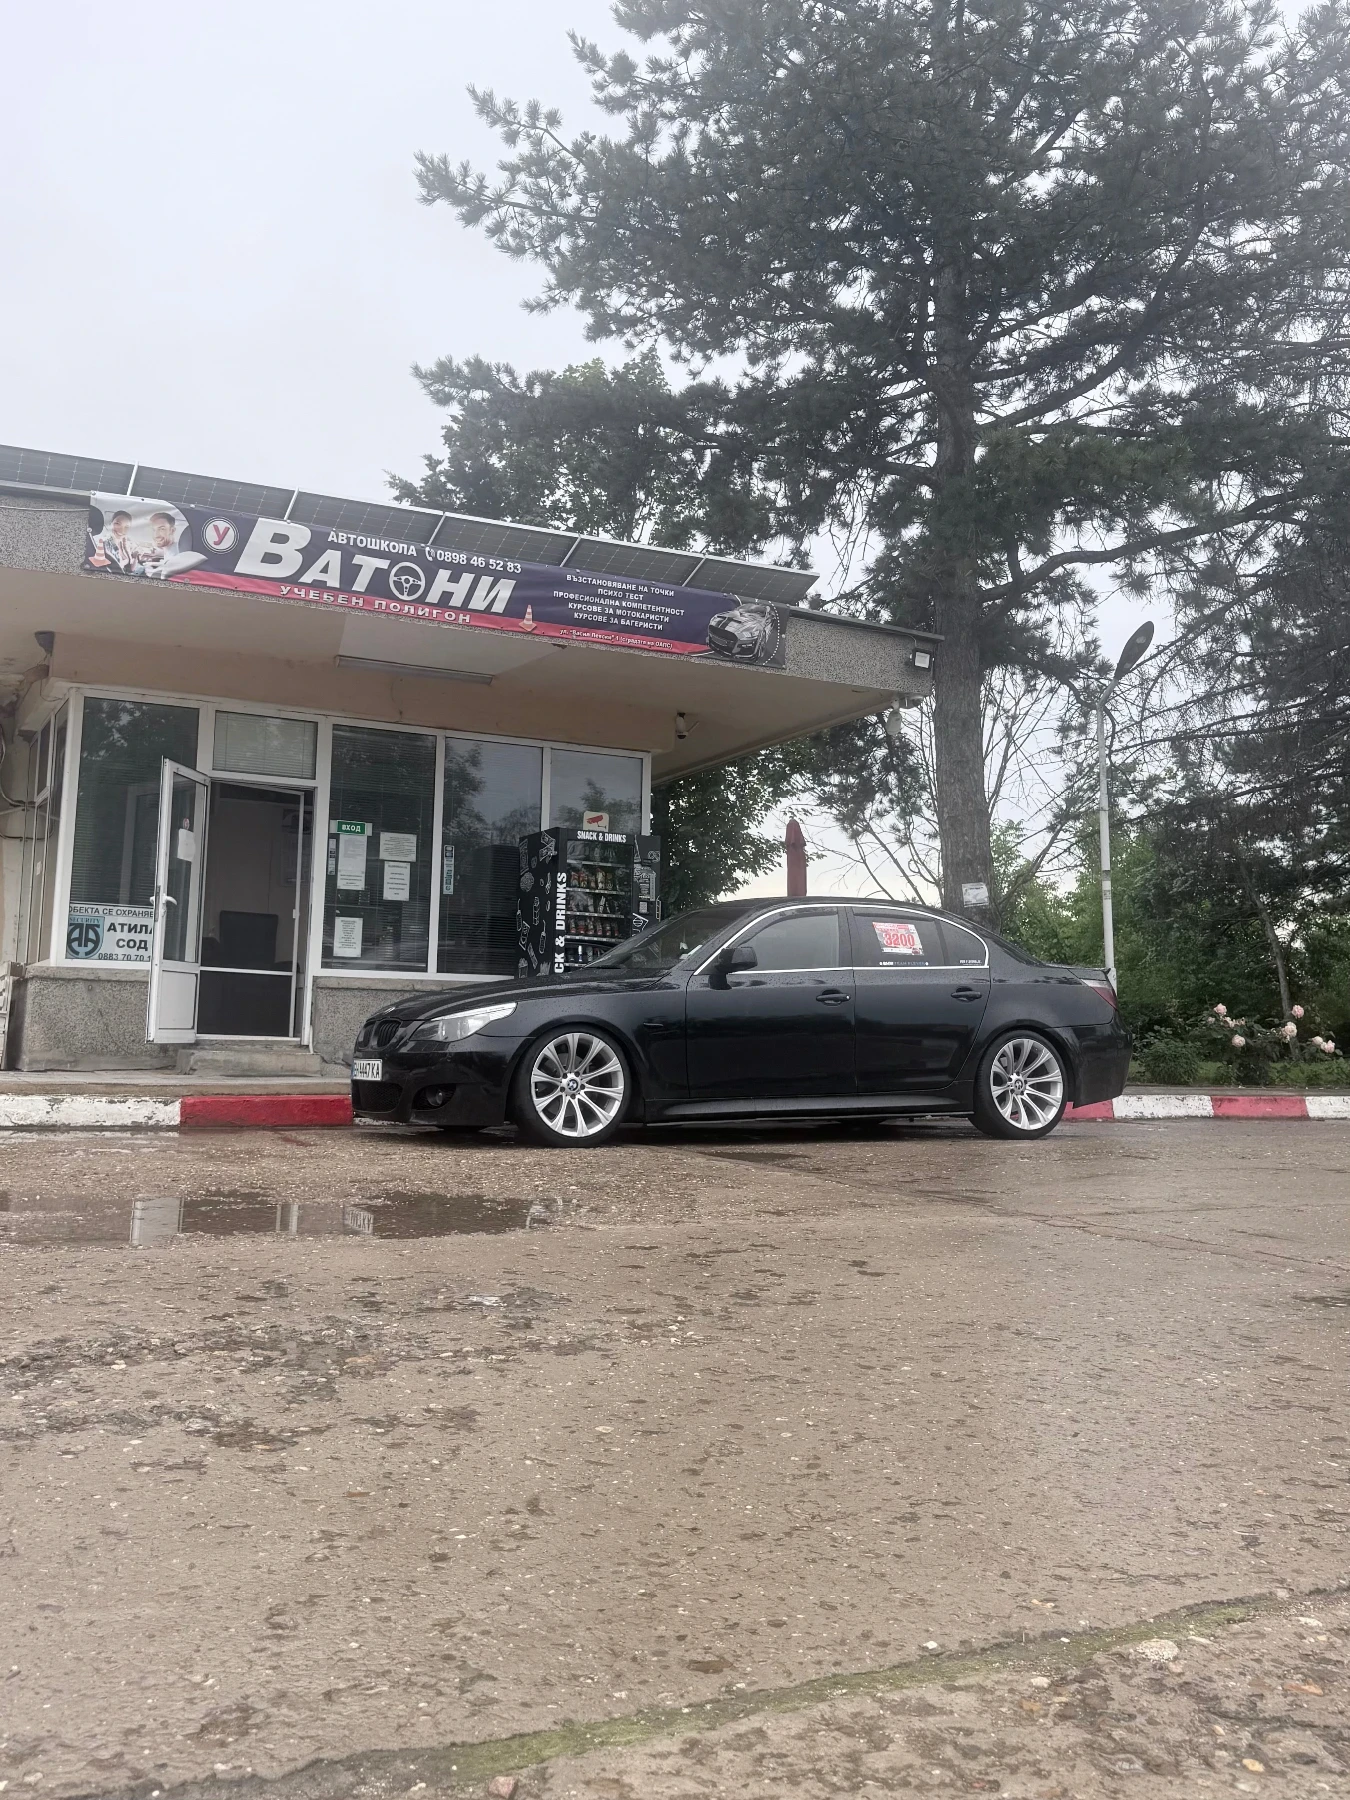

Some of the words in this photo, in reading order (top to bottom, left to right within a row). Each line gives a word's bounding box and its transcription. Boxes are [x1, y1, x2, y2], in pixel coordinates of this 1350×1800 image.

[328, 530, 417, 557] АВТОШКОЛА
[436, 551, 467, 566] 0898
[470, 554, 485, 568] 46
[488, 558, 504, 571] 52
[506, 561, 522, 574] 83
[566, 574, 636, 591] ВЪЗСТАНОВЯВАНЕ
[638, 585, 648, 593] НА
[650, 587, 674, 597] ТОЧКИ
[597, 588, 623, 598] ПСИХО
[625, 592, 643, 601] ТЕСТ
[279, 585, 364, 607] УЧЕБЕН
[374, 599, 471, 624] ПОЛИГОН
[553, 590, 620, 606] ПРОФЕСИОНАЛНА
[622, 600, 685, 616] КОМПЕТЕНТНОСТ
[568, 602, 602, 613] КУРСОВЕ
[604, 607, 613, 615] ЗА
[615, 609, 669, 623] МОТОКАРИСТИ
[573, 612, 608, 623] КУРСОВЕ
[609, 617, 618, 625] ЗА
[620, 618, 663, 631] БАГЕРИСТИ
[341, 824, 361, 832] ВХОД
[577, 830, 597, 841] SNACK
[598, 833, 604, 841] &
[604, 833, 627, 843] DRINKS
[556, 872, 567, 930] DRINKS
[116, 938, 148, 951] СОД
[555, 935, 565, 947] &
[98, 952, 119, 961] 0883
[121, 953, 131, 961] 70
